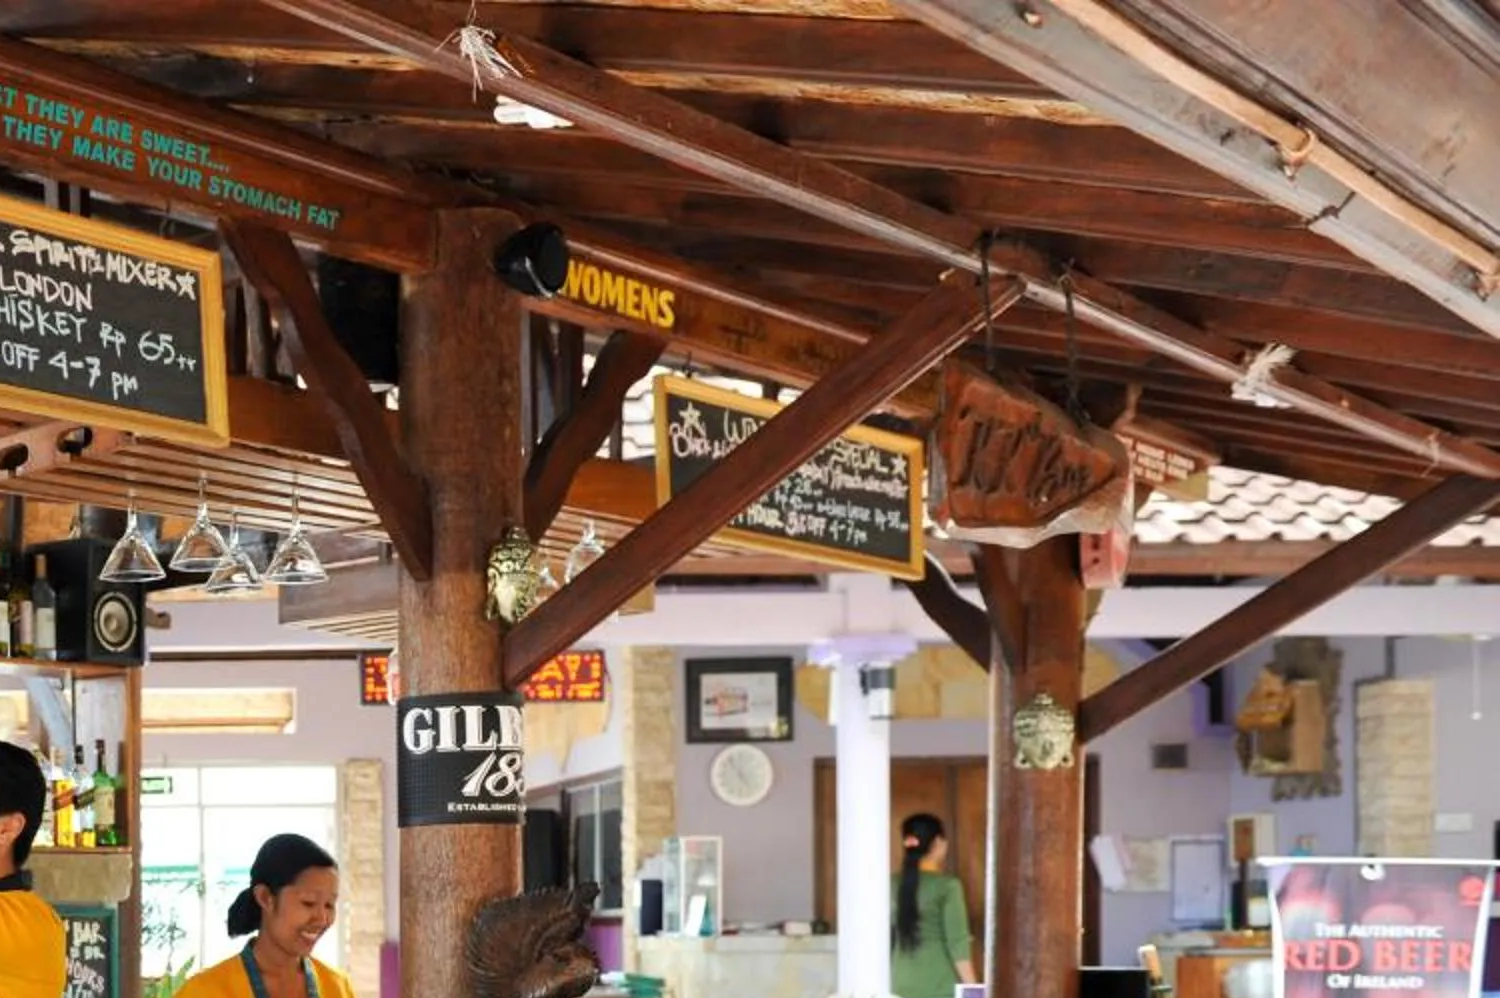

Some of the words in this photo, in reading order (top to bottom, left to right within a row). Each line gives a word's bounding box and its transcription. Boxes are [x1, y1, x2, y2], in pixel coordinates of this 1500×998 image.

[24, 95, 85, 130] THEY
[91, 115, 133, 145] ARE
[3, 115, 63, 150] THEY
[72, 136, 136, 172] MAKE
[147, 157, 203, 191] YOUR
[208, 177, 302, 222] STOMACH
[307, 204, 341, 231] FAT
[0, 265, 93, 313] LONDON
[105, 251, 178, 292] MIXER
[0, 340, 41, 373] OFF
[1315, 922, 1346, 938] THE
[1349, 923, 1445, 938] AUTHENTIC
[1284, 939, 1361, 971] RED
[1373, 940, 1473, 972] BEER
[1354, 974, 1425, 989] IRELAND
